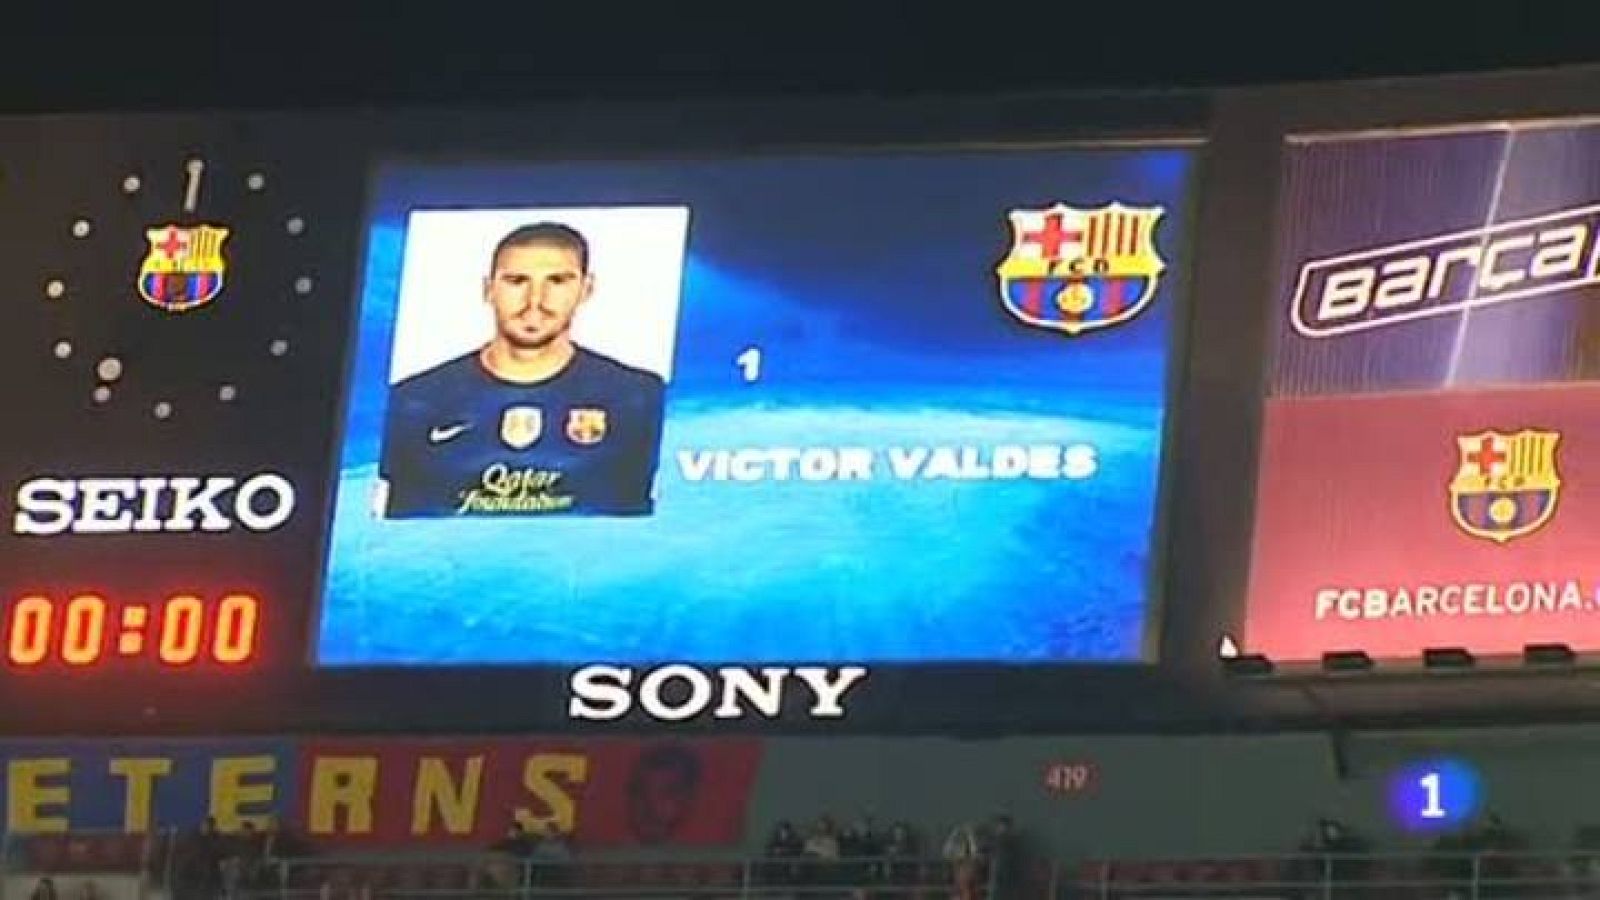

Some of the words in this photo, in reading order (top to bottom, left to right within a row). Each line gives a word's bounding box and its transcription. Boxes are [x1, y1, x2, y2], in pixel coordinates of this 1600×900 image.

[736, 348, 761, 382] 1
[678, 447, 872, 480] VICTOR
[889, 444, 1097, 479] VALDES
[14, 473, 294, 533] SEIKO
[1315, 580, 1600, 621] FCBARCELONA.
[9, 595, 257, 664] 00:00
[569, 664, 866, 719] SONY
[7, 752, 589, 834] ETERNS
